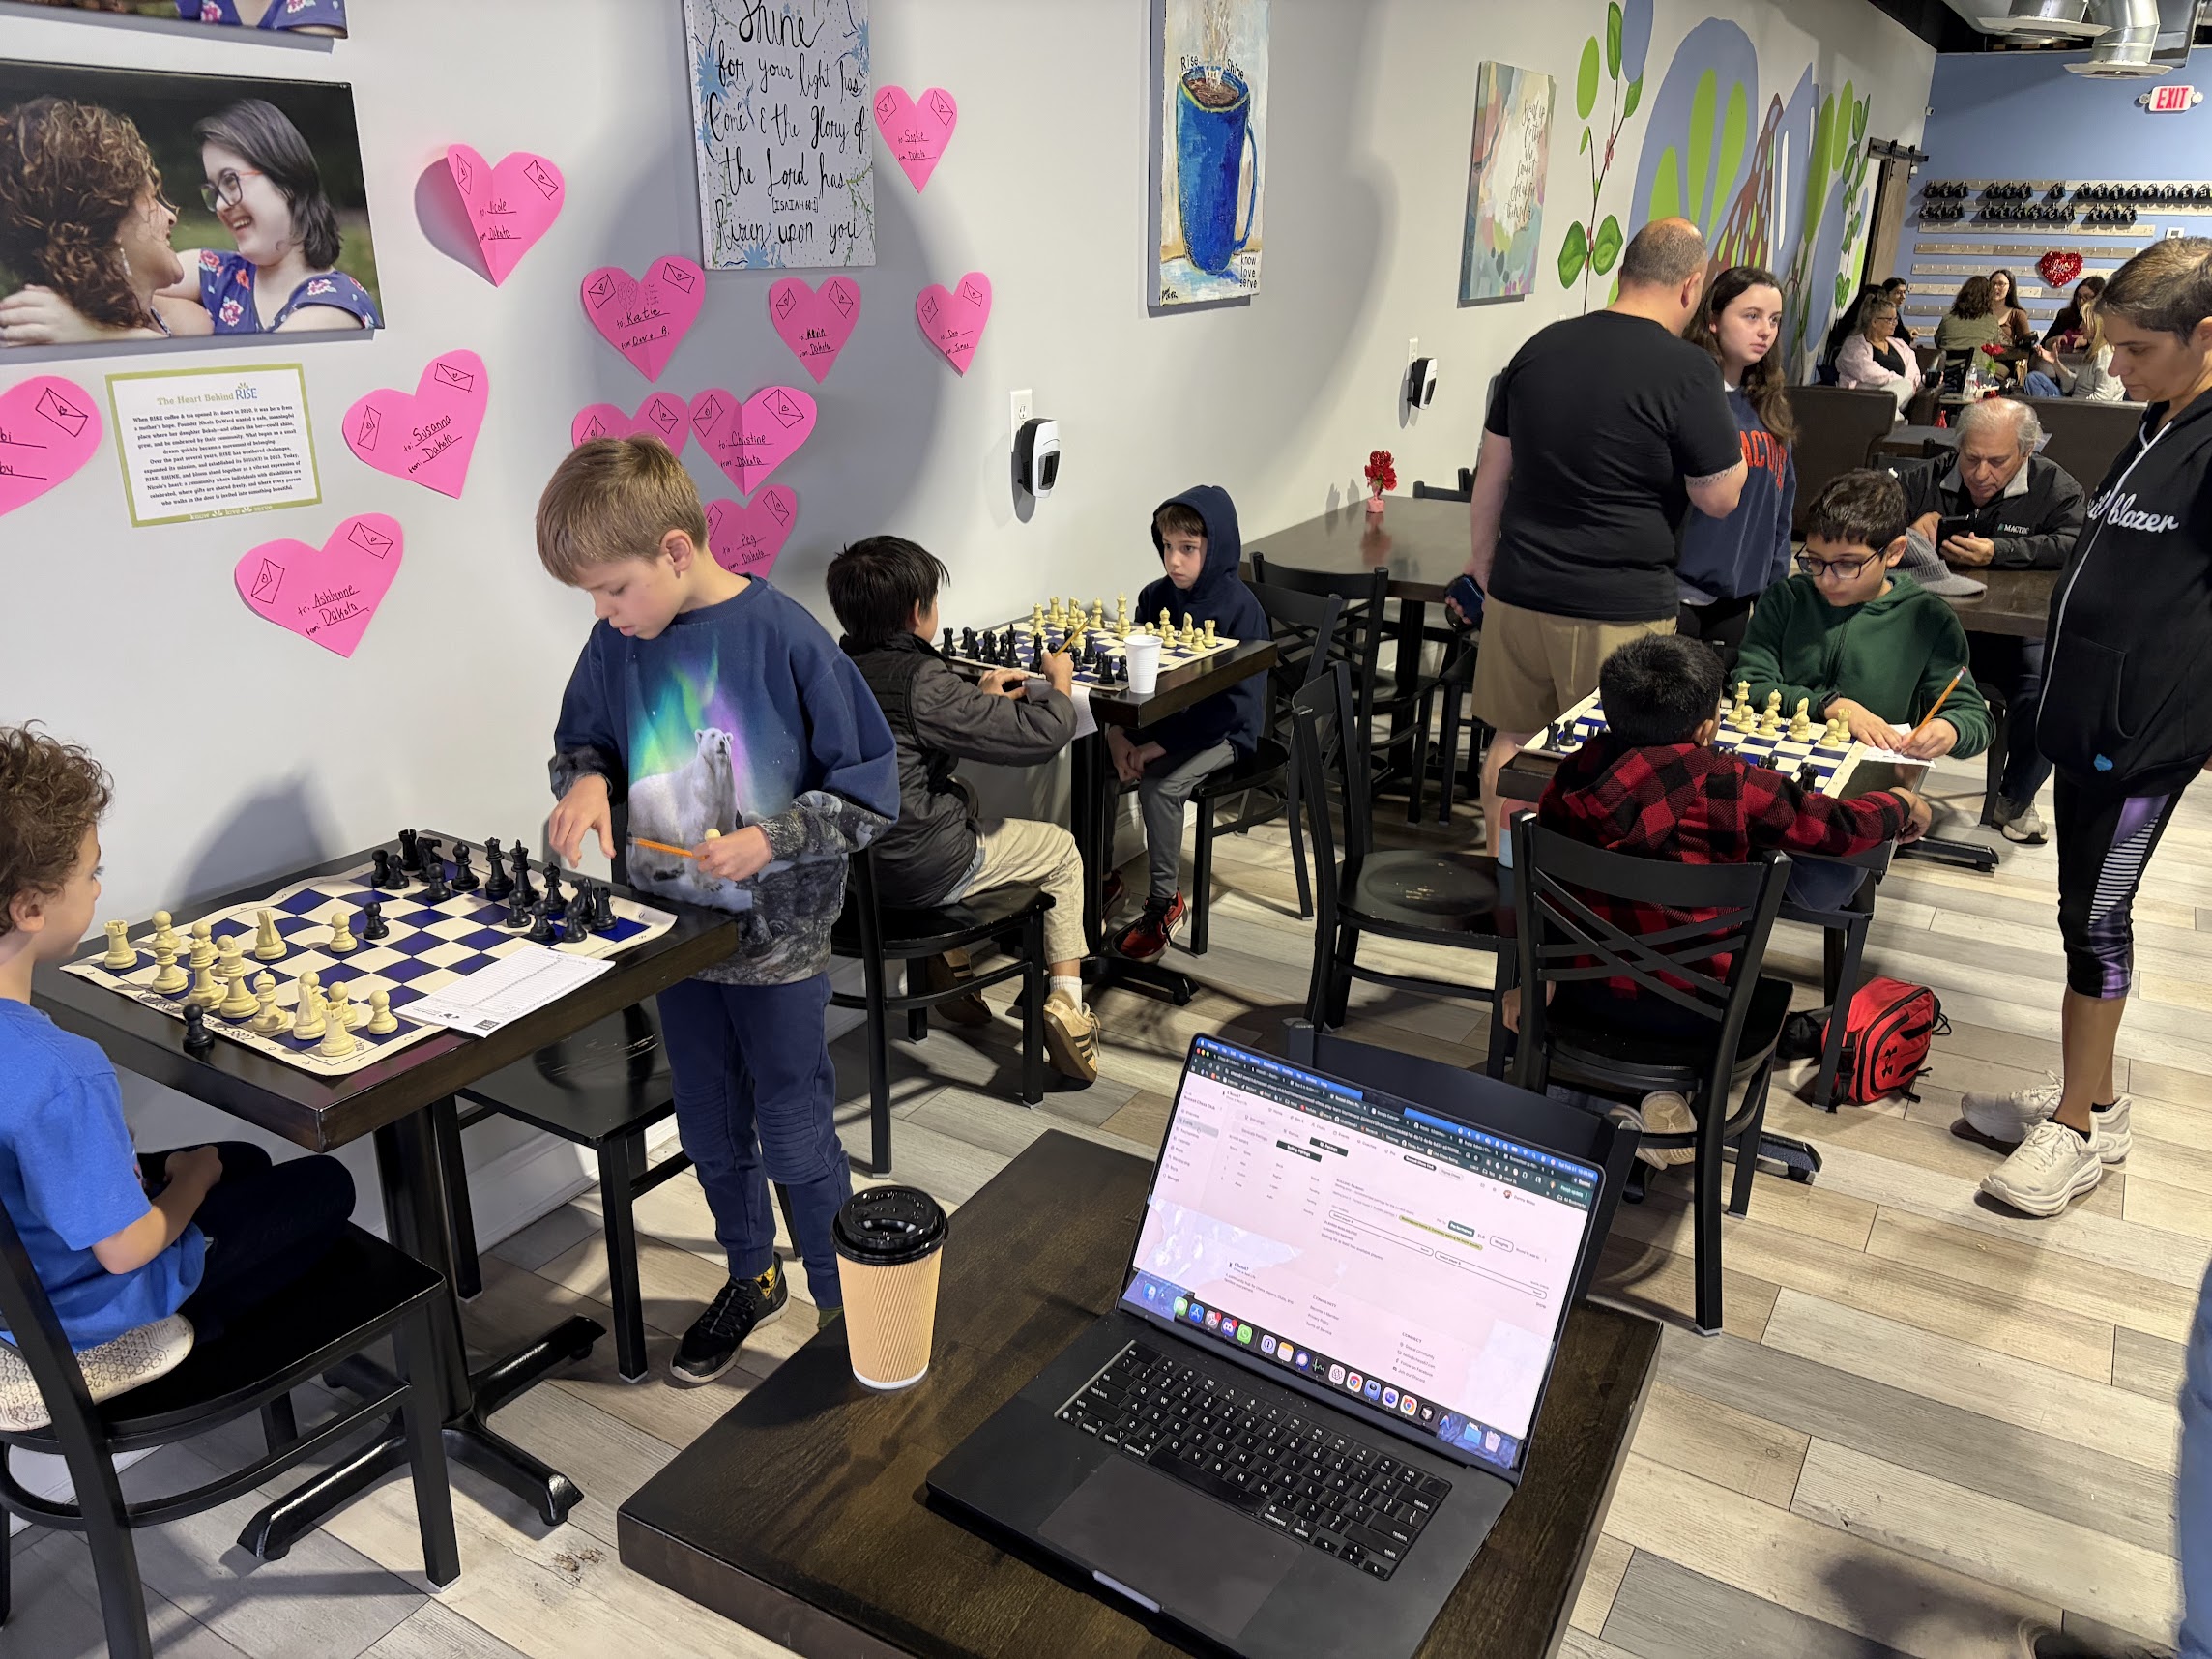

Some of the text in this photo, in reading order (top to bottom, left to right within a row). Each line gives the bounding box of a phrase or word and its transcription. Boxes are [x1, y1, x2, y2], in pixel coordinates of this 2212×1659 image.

[715, 39, 864, 104] for your light has
[1180, 54, 1199, 71] Rise
[1227, 58, 1244, 79] Shine
[2156, 88, 2189, 109] EXIT
[709, 91, 748, 142] Come
[771, 103, 800, 146] the
[811, 105, 850, 153] glory
[854, 106, 868, 154] of
[719, 146, 846, 199] the Lord has
[778, 222, 813, 255] upon
[830, 221, 866, 254] you
[1240, 253, 1256, 266] know
[1240, 266, 1256, 277] love
[1239, 278, 1257, 289] serve
[626, 306, 660, 325] Katie
[157, 388, 258, 405] The Heart Behind RISE
[413, 415, 452, 442] Susanna
[731, 430, 766, 446] Christine
[422, 434, 453, 459] Dakota
[742, 534, 757, 548] Peg
[314, 584, 357, 607] Ashlynne
[319, 601, 359, 626] Dakota
[1414, 1499, 1429, 1510] delete
[1265, 1512, 1287, 1527] command
